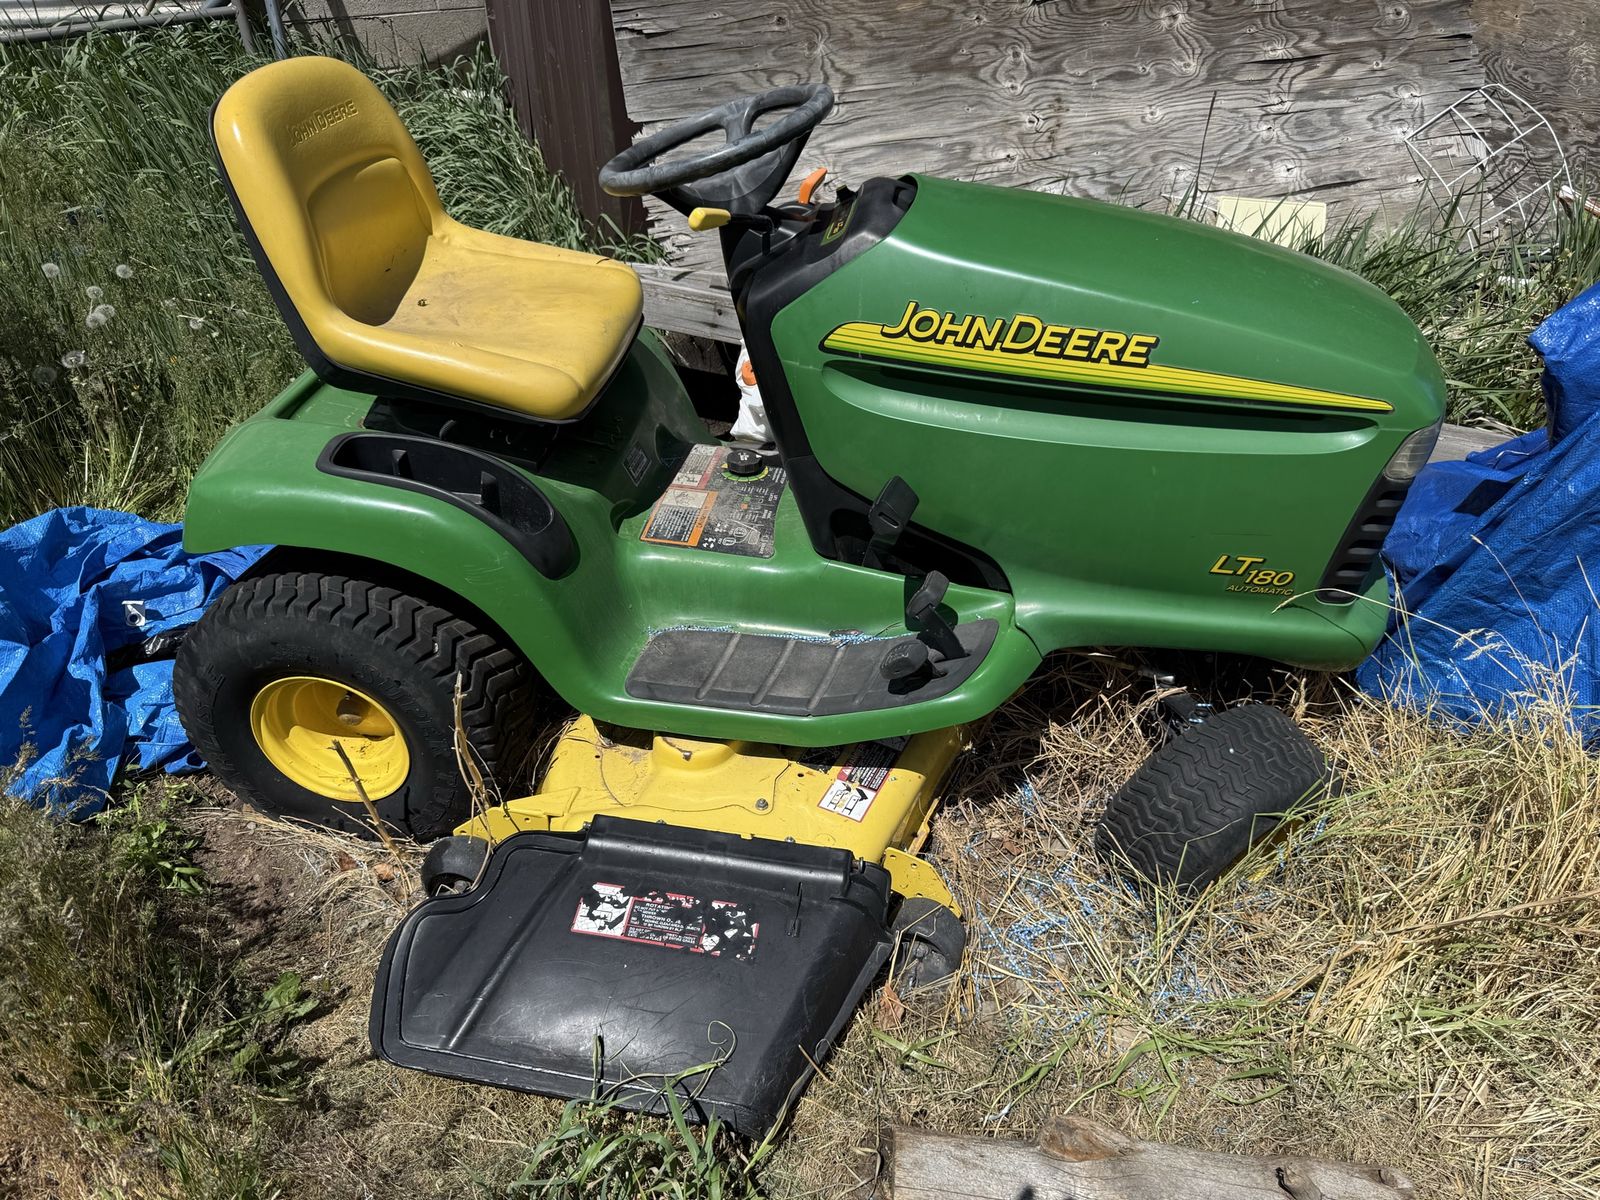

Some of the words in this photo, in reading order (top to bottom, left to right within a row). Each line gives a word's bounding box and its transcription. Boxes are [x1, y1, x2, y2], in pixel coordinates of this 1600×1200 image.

[288, 117, 318, 147] JOHN
[313, 99, 359, 131] DEERE
[880, 300, 1005, 351] JOHN
[1000, 313, 1160, 369] DEERE
[1226, 584, 1295, 596] AUTOMATIC
[641, 913, 666, 922] THROWN
